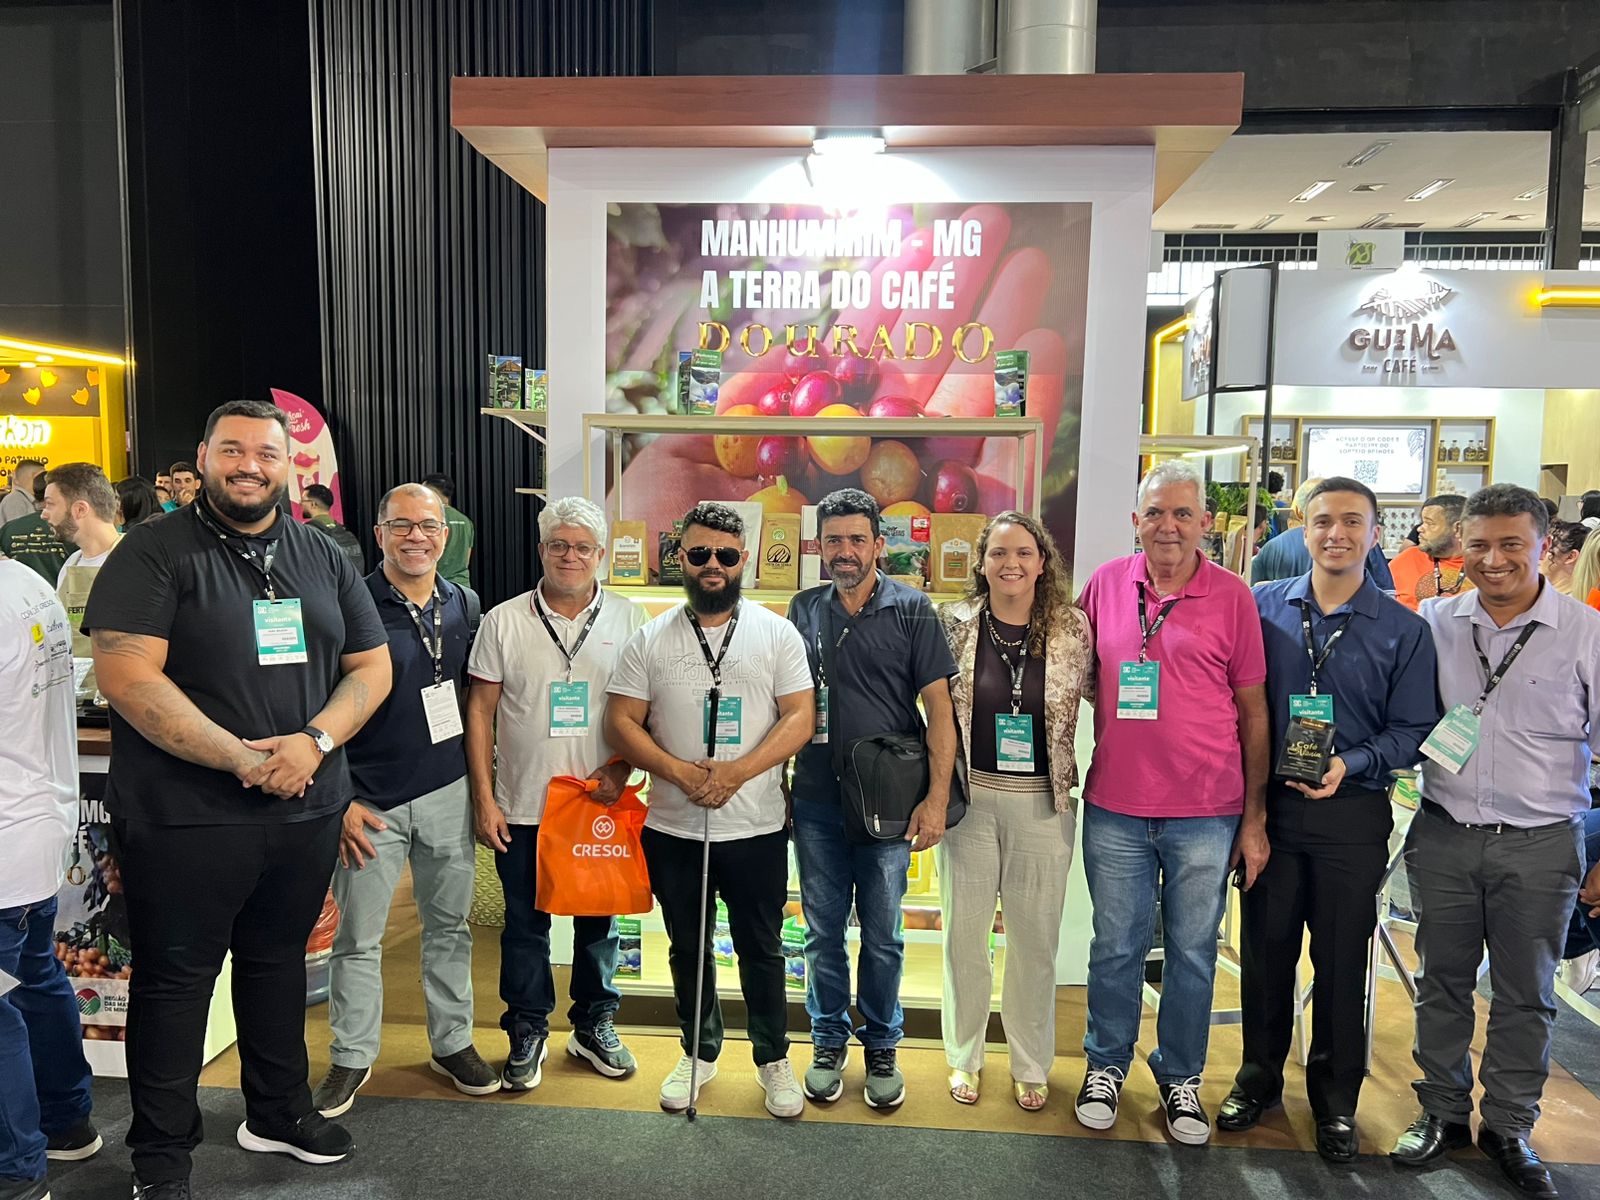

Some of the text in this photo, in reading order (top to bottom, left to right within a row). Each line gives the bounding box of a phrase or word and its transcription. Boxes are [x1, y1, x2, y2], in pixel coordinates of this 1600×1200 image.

[933, 219, 982, 257] MG
[700, 261, 955, 310] A TERRA DO CAFÉ
[697, 320, 995, 363] DOURADO
[1349, 323, 1456, 360] GUIMA
[1384, 356, 1417, 374] CAFÉ
[290, 418, 311, 433] resh
[655, 654, 762, 682] ORIGIALS
[80, 799, 111, 824] MG
[572, 843, 631, 858] CRESOL
[104, 994, 127, 1002] REGIÃO
